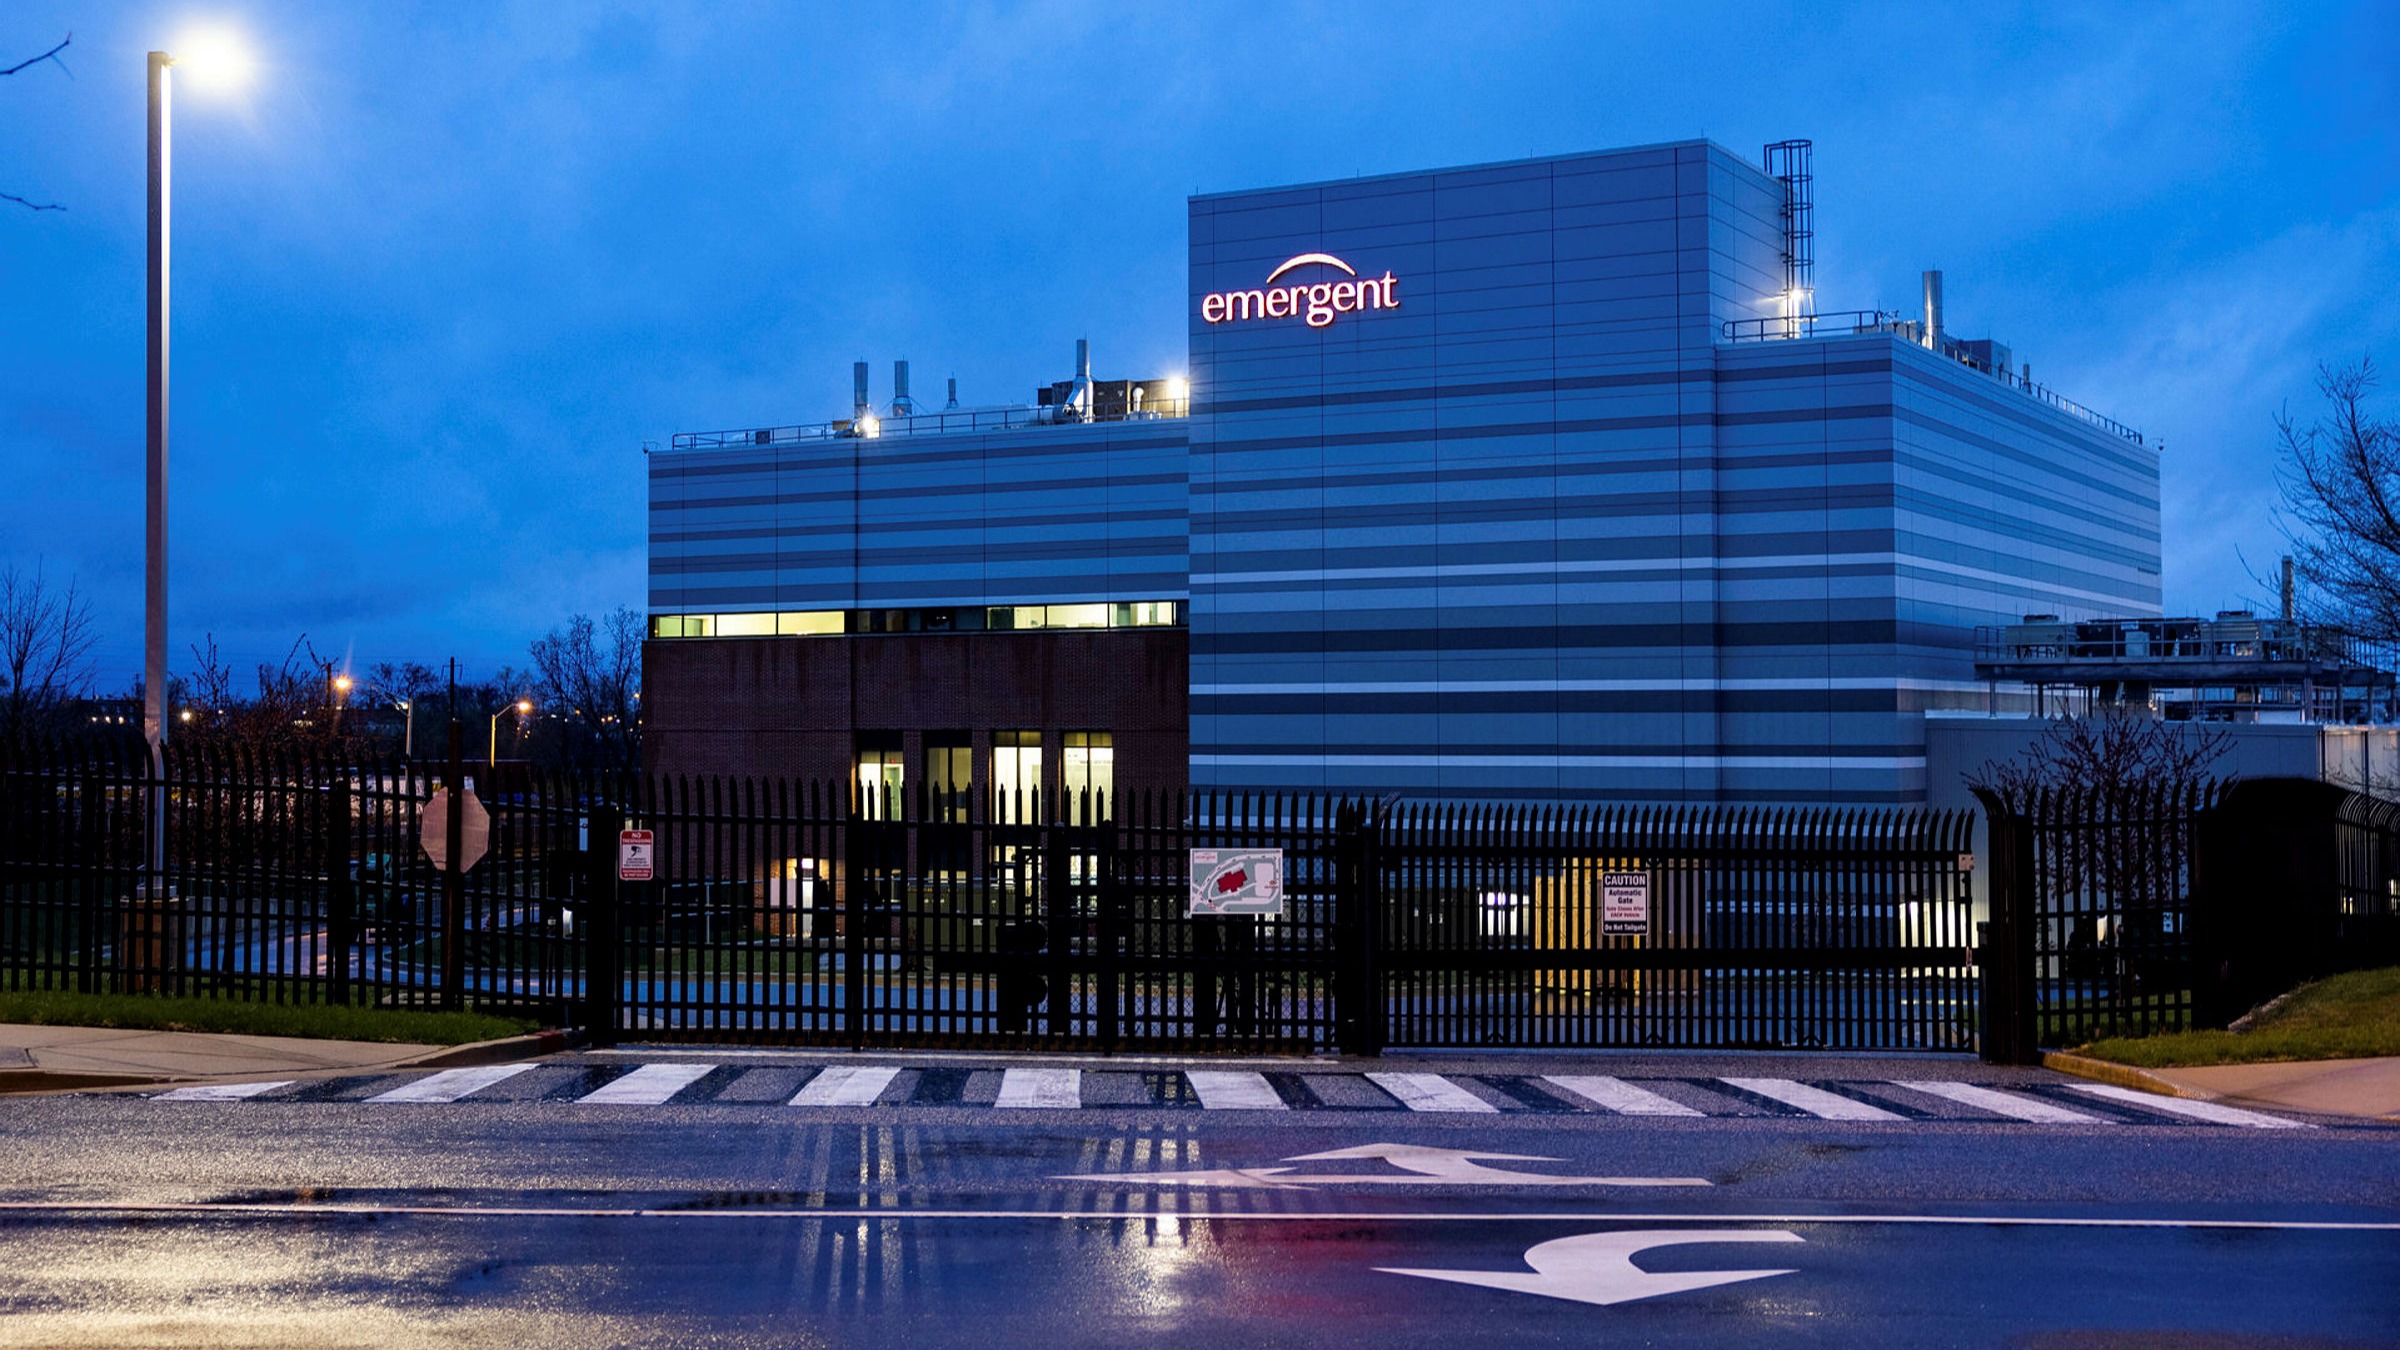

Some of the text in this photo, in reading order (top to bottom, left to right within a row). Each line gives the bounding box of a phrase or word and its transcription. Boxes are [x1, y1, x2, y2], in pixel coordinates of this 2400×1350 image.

[1202, 270, 1400, 328] emergent
[1604, 875, 1646, 885] CAUTION
[1624, 923, 1646, 932] Tailgate
